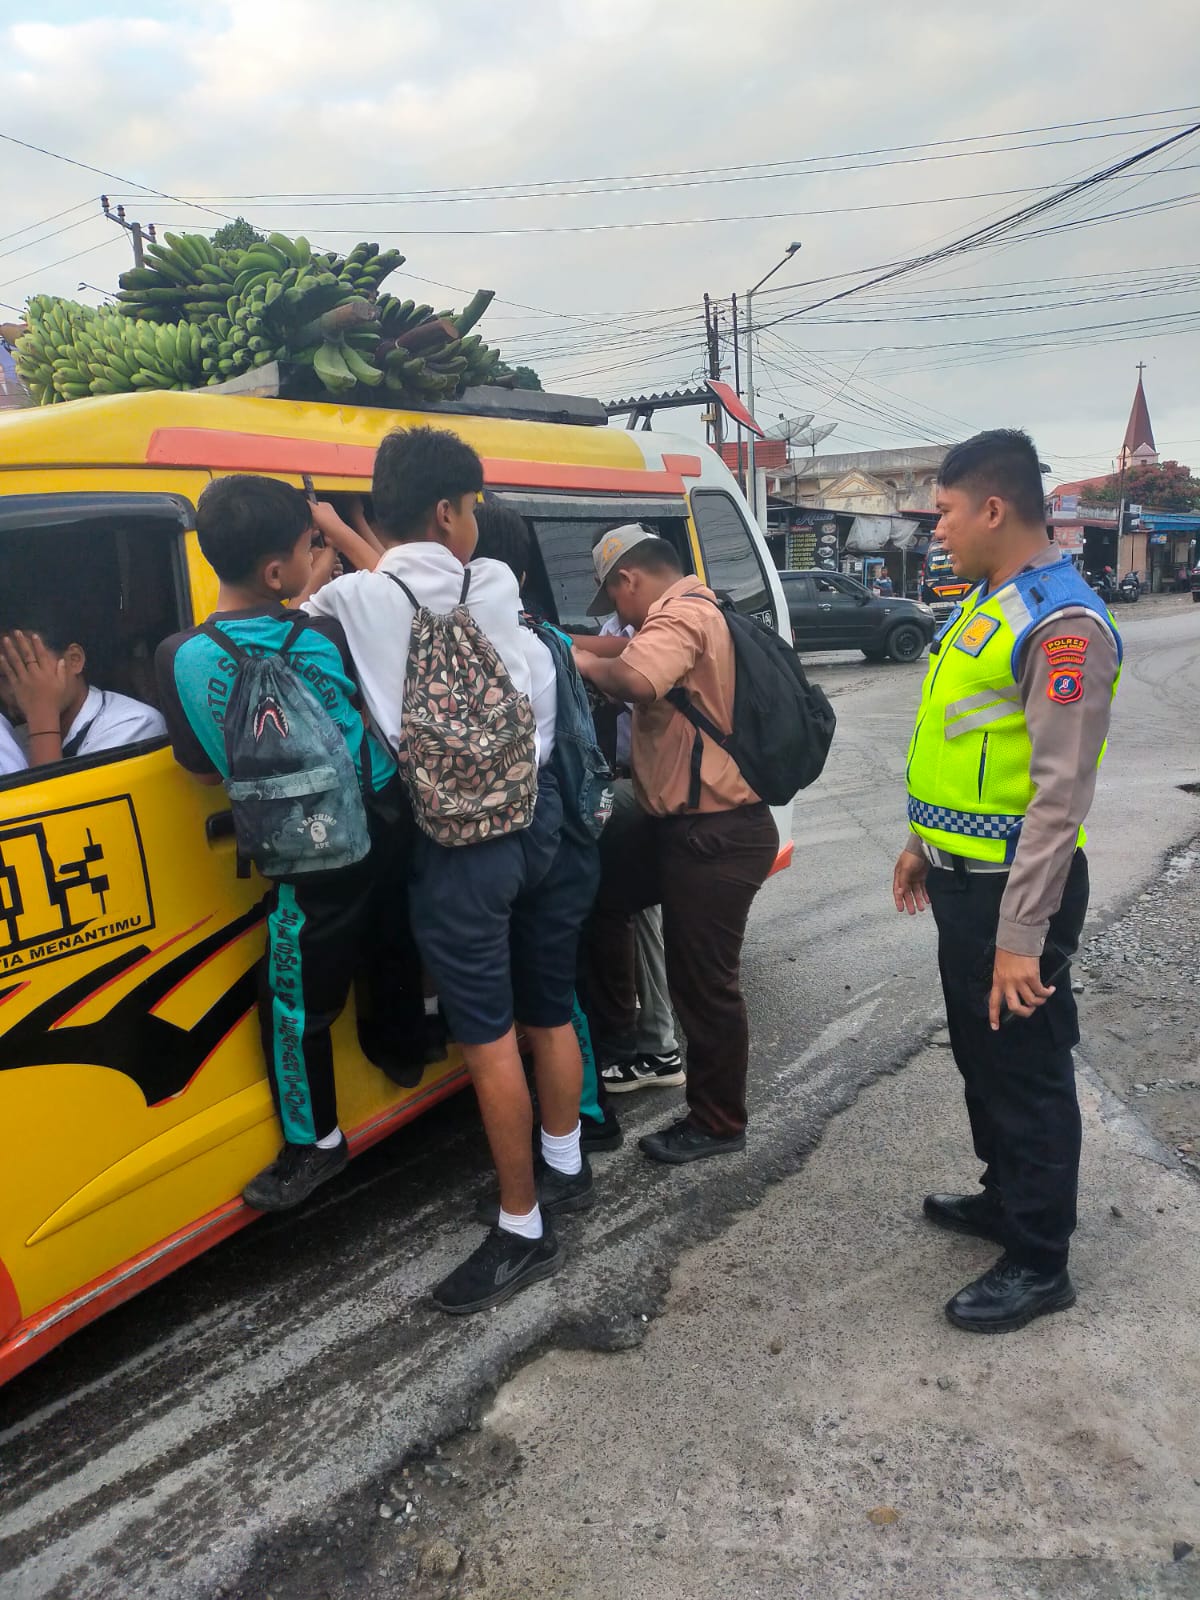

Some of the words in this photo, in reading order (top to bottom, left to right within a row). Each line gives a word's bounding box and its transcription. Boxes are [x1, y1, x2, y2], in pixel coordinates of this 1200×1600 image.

[1047, 638, 1085, 649] POLRES
[207, 677, 228, 732] PTD
[291, 653, 339, 710] EGERI
[0, 953, 23, 969] IA
[29, 915, 142, 960] MENANTIMU
